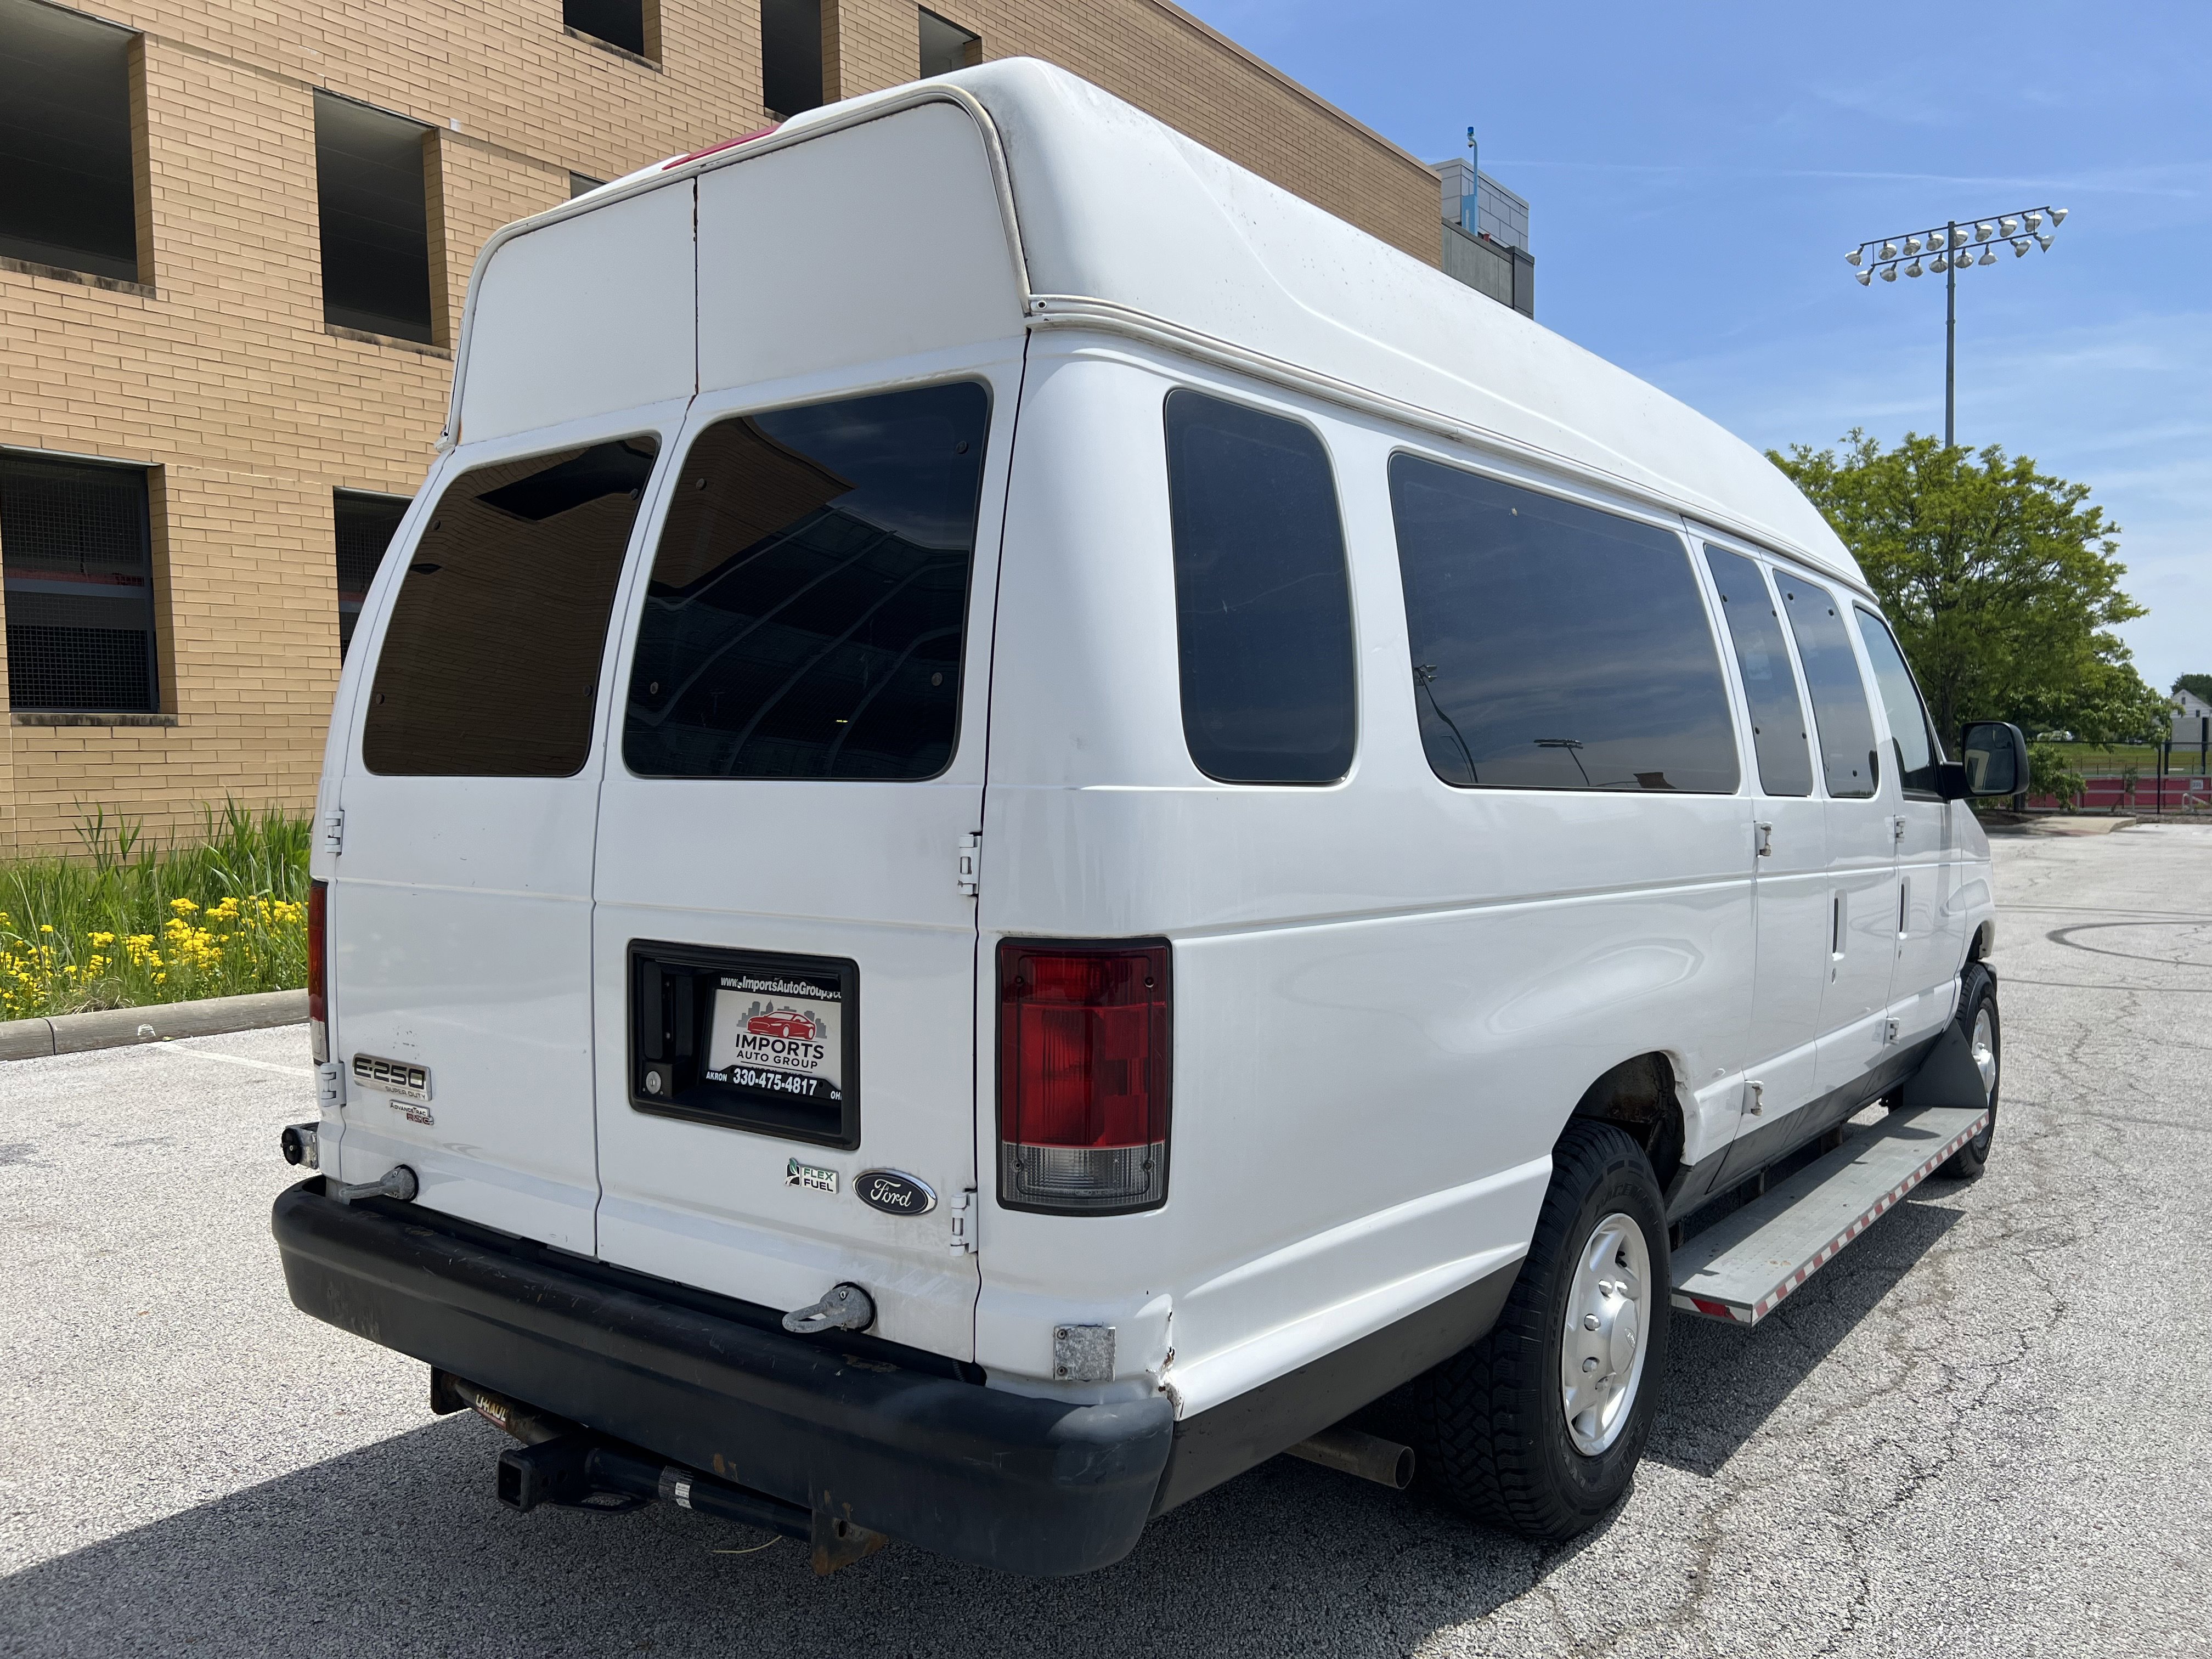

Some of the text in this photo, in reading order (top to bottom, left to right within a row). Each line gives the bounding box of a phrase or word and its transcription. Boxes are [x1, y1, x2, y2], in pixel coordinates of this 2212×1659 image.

[721, 975, 842, 1000] wwwImportsAutoGroupco
[735, 1034, 824, 1060] IMPORTS
[736, 1049, 818, 1069] AUTO GROUP
[706, 1071, 727, 1082] AKRON
[733, 1068, 817, 1096] 330-475-4817
[385, 1086, 425, 1099] SUPER DUTY
[406, 1113, 431, 1126] RSC
[804, 1167, 834, 1182] FLEX
[804, 1178, 834, 1193] FUEL
[870, 1178, 912, 1208] Ford
